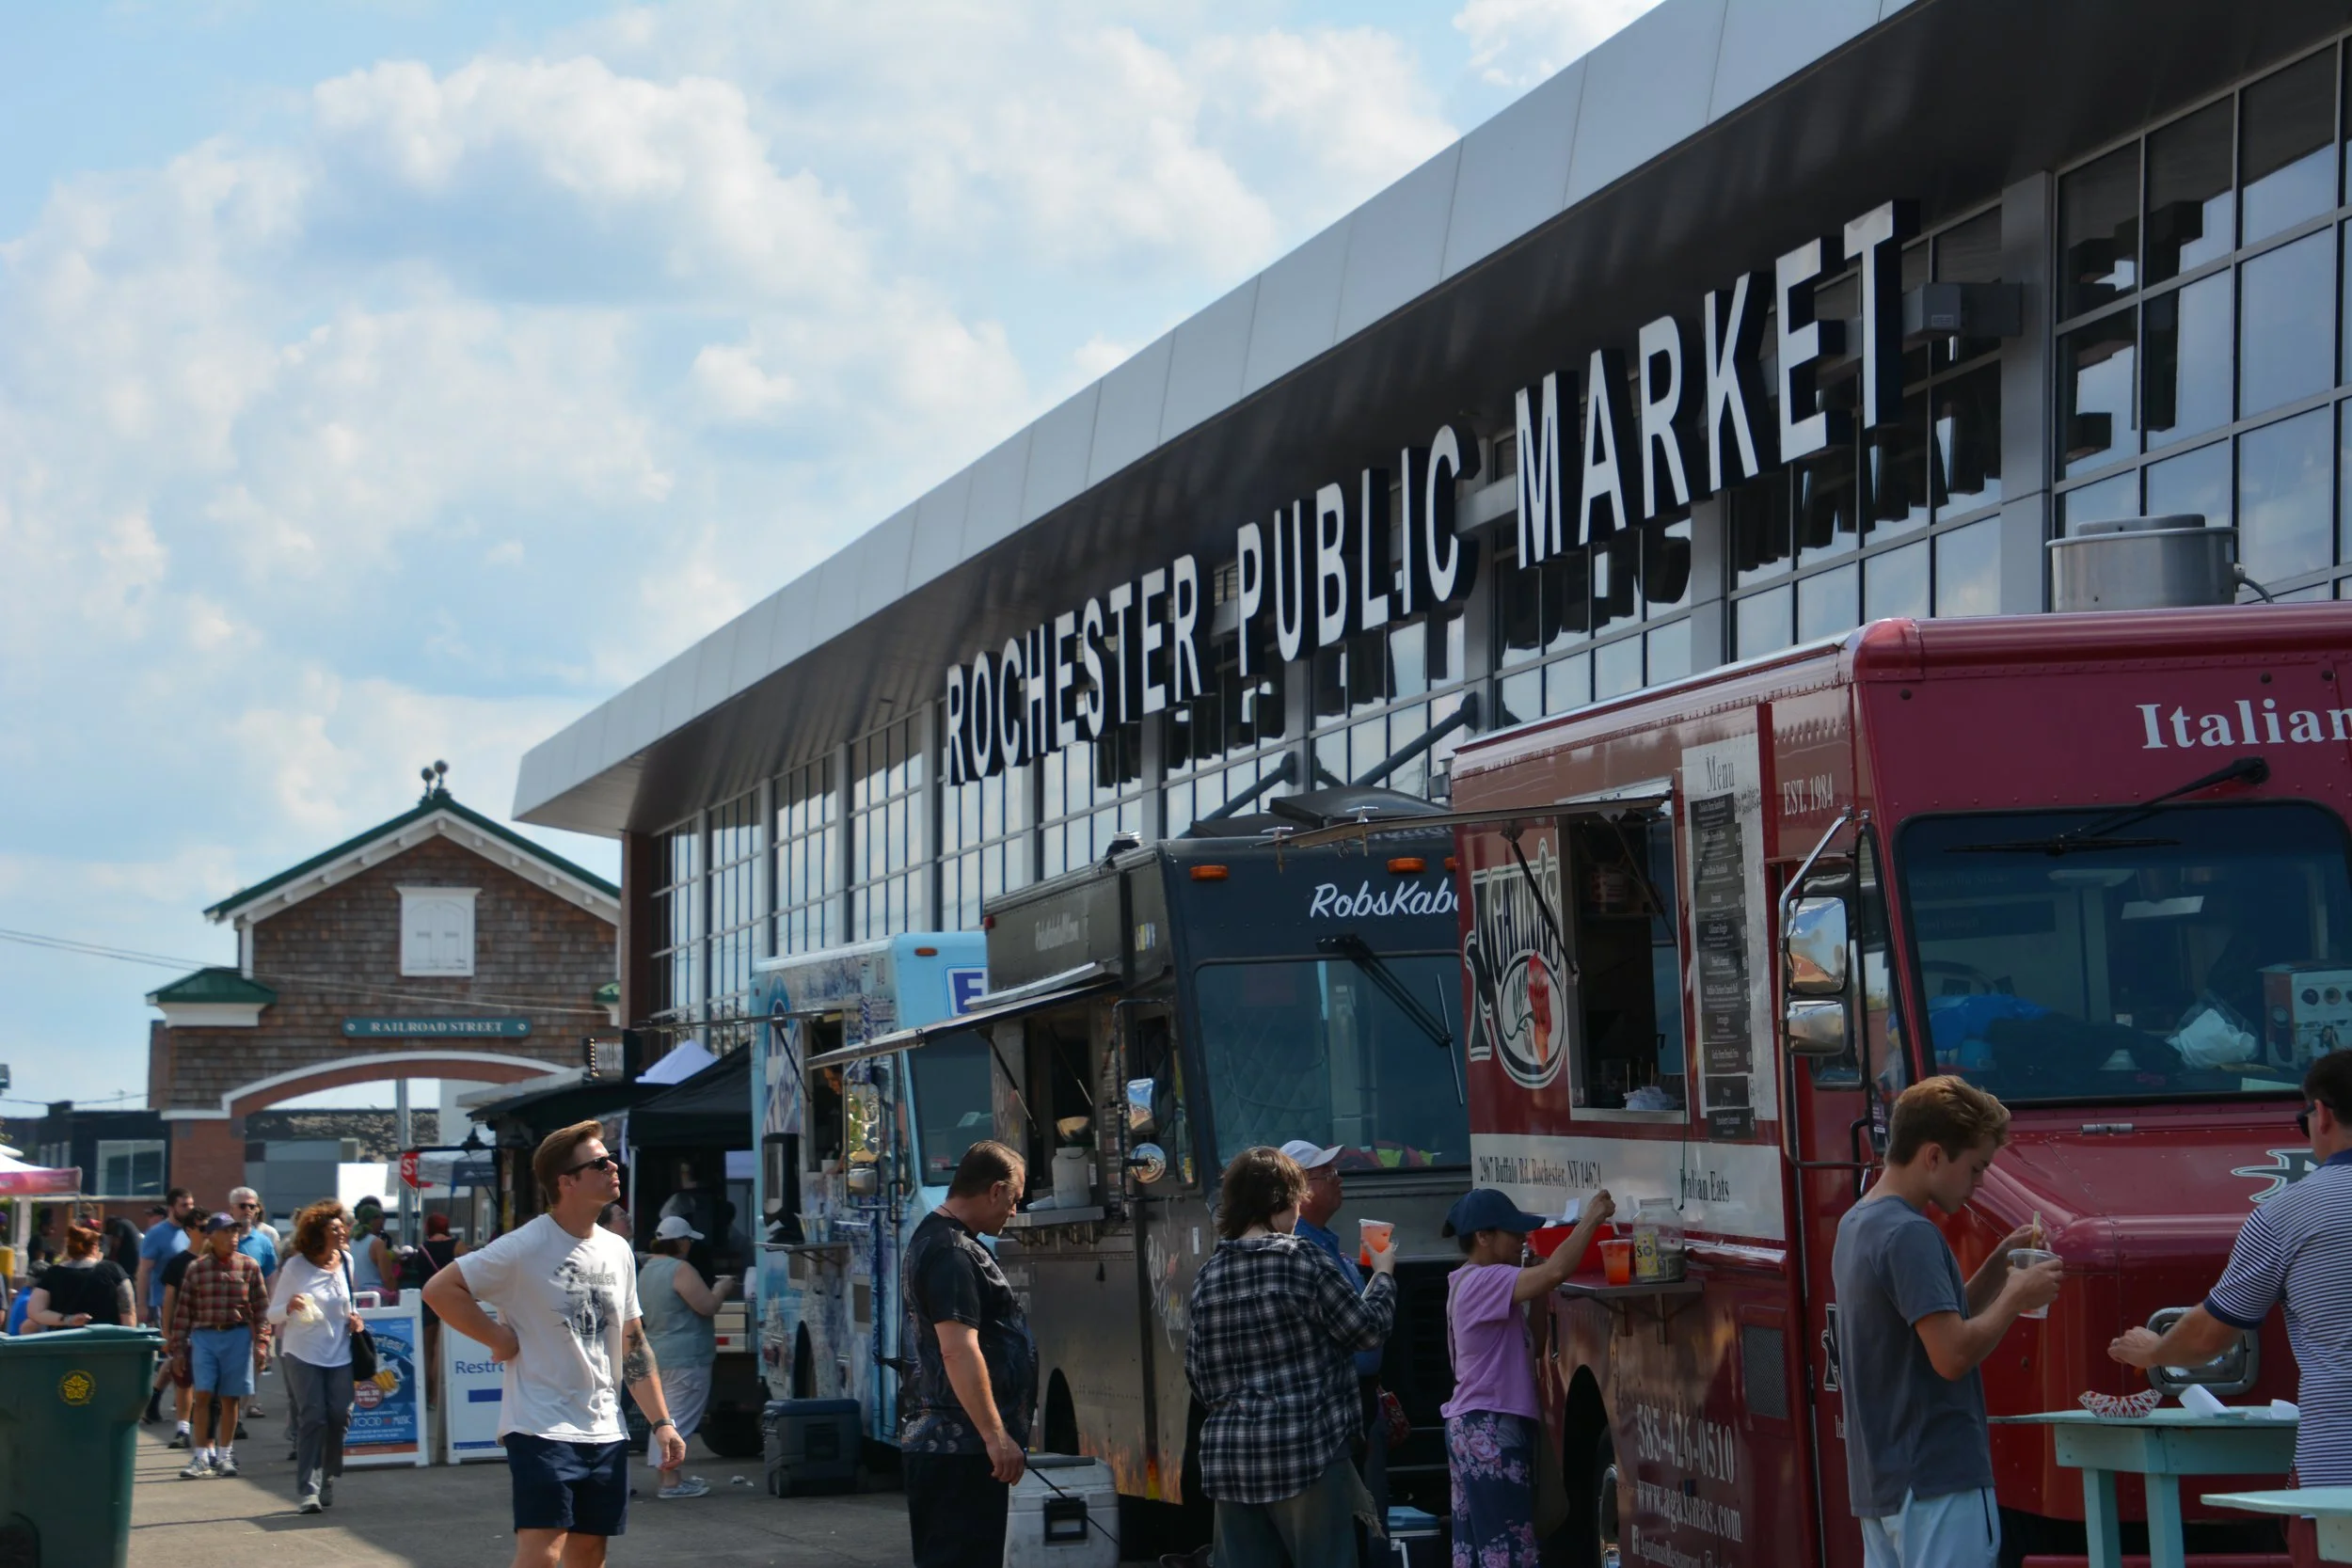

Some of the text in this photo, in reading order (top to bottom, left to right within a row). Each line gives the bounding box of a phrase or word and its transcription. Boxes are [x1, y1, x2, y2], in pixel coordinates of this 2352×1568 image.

[946, 200, 1894, 786] ROCHESTER PUBLIC MARKET
[1706, 755, 1736, 793] Menu
[1783, 780, 1808, 816] EST.
[1810, 772, 1834, 812] 1984
[1309, 877, 1458, 919] RobsKab
[370, 1021, 503, 1033] RAILROAD STREET
[1494, 1156, 1518, 1185] Buffalo
[1567, 1161, 1579, 1189] NY
[1680, 1168, 1730, 1202] Italian Eats
[454, 1360, 505, 1374] Restro
[1636, 1402, 1735, 1484] 585-426-0510
[1636, 1479, 1743, 1544] www.agatinas.com
